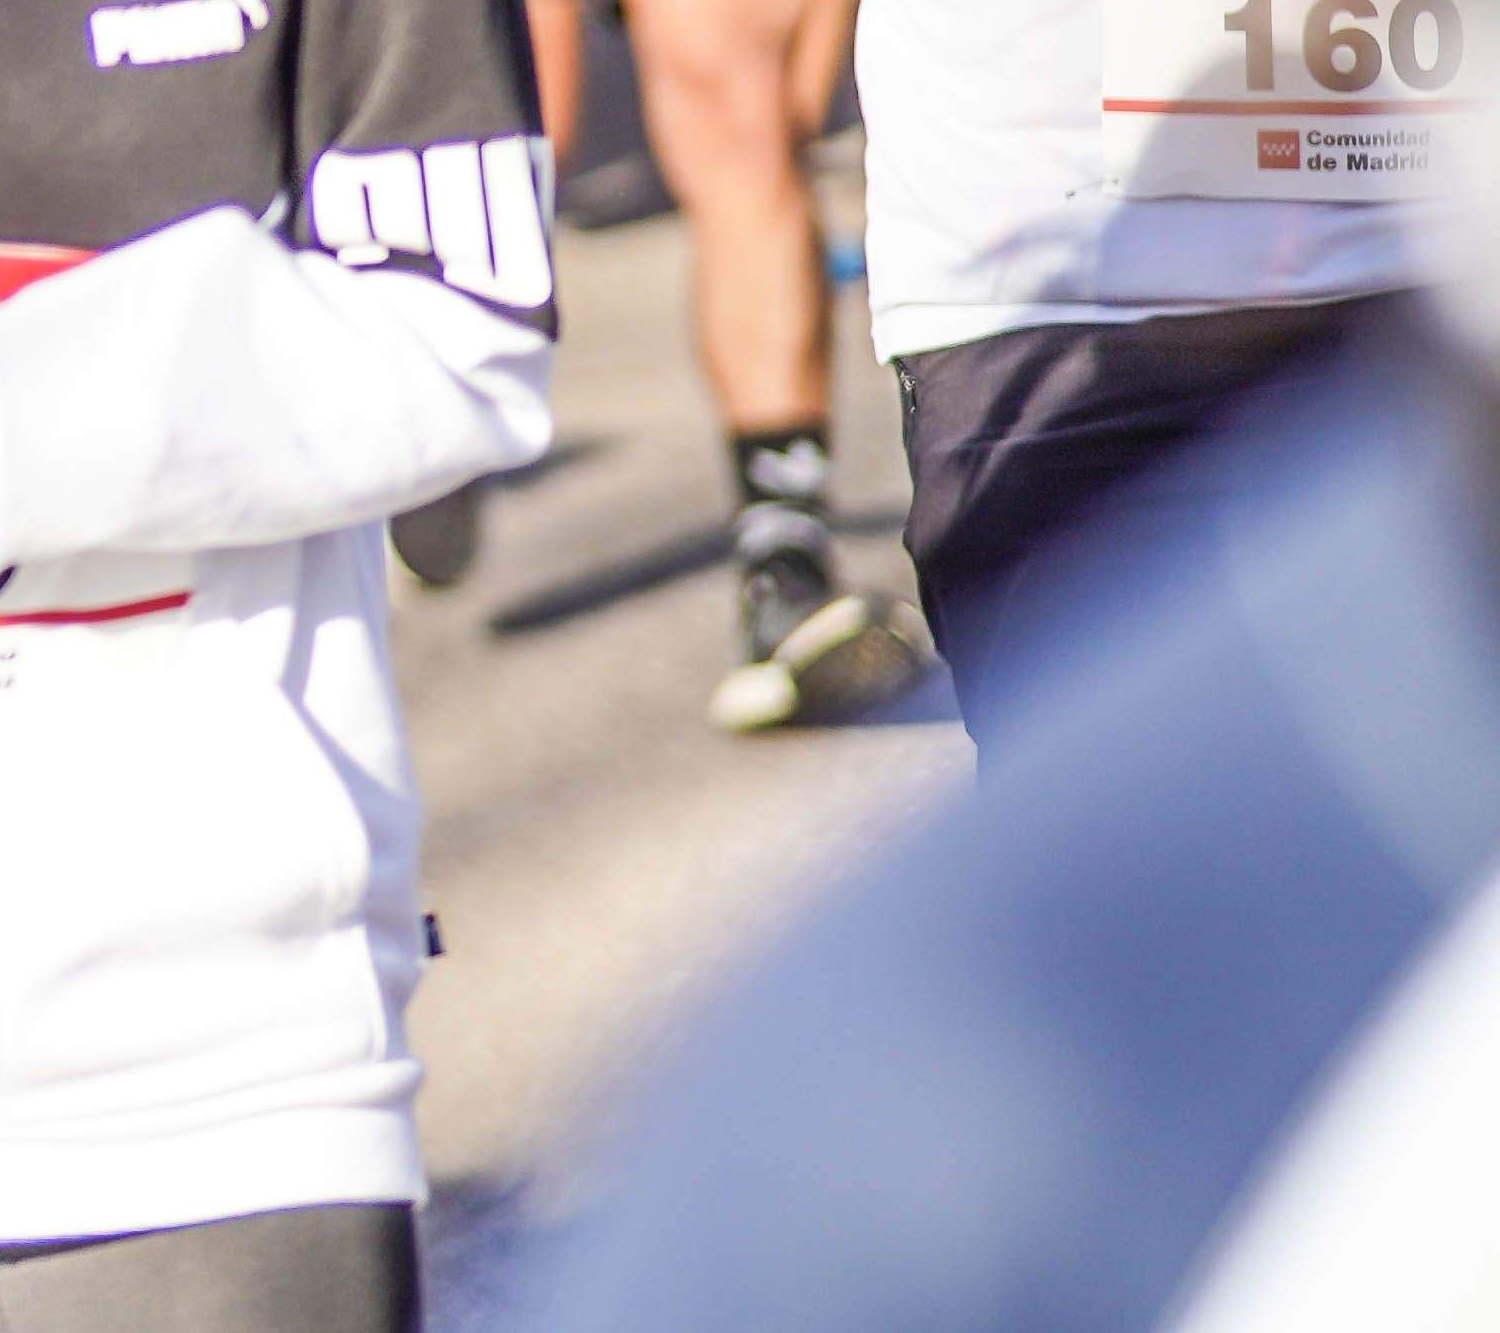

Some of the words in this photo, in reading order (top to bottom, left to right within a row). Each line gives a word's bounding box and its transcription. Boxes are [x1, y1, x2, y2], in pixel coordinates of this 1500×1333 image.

[1306, 129, 1431, 148] Comunidad
[1306, 151, 1338, 172] de
[1346, 150, 1430, 172] Madrid
